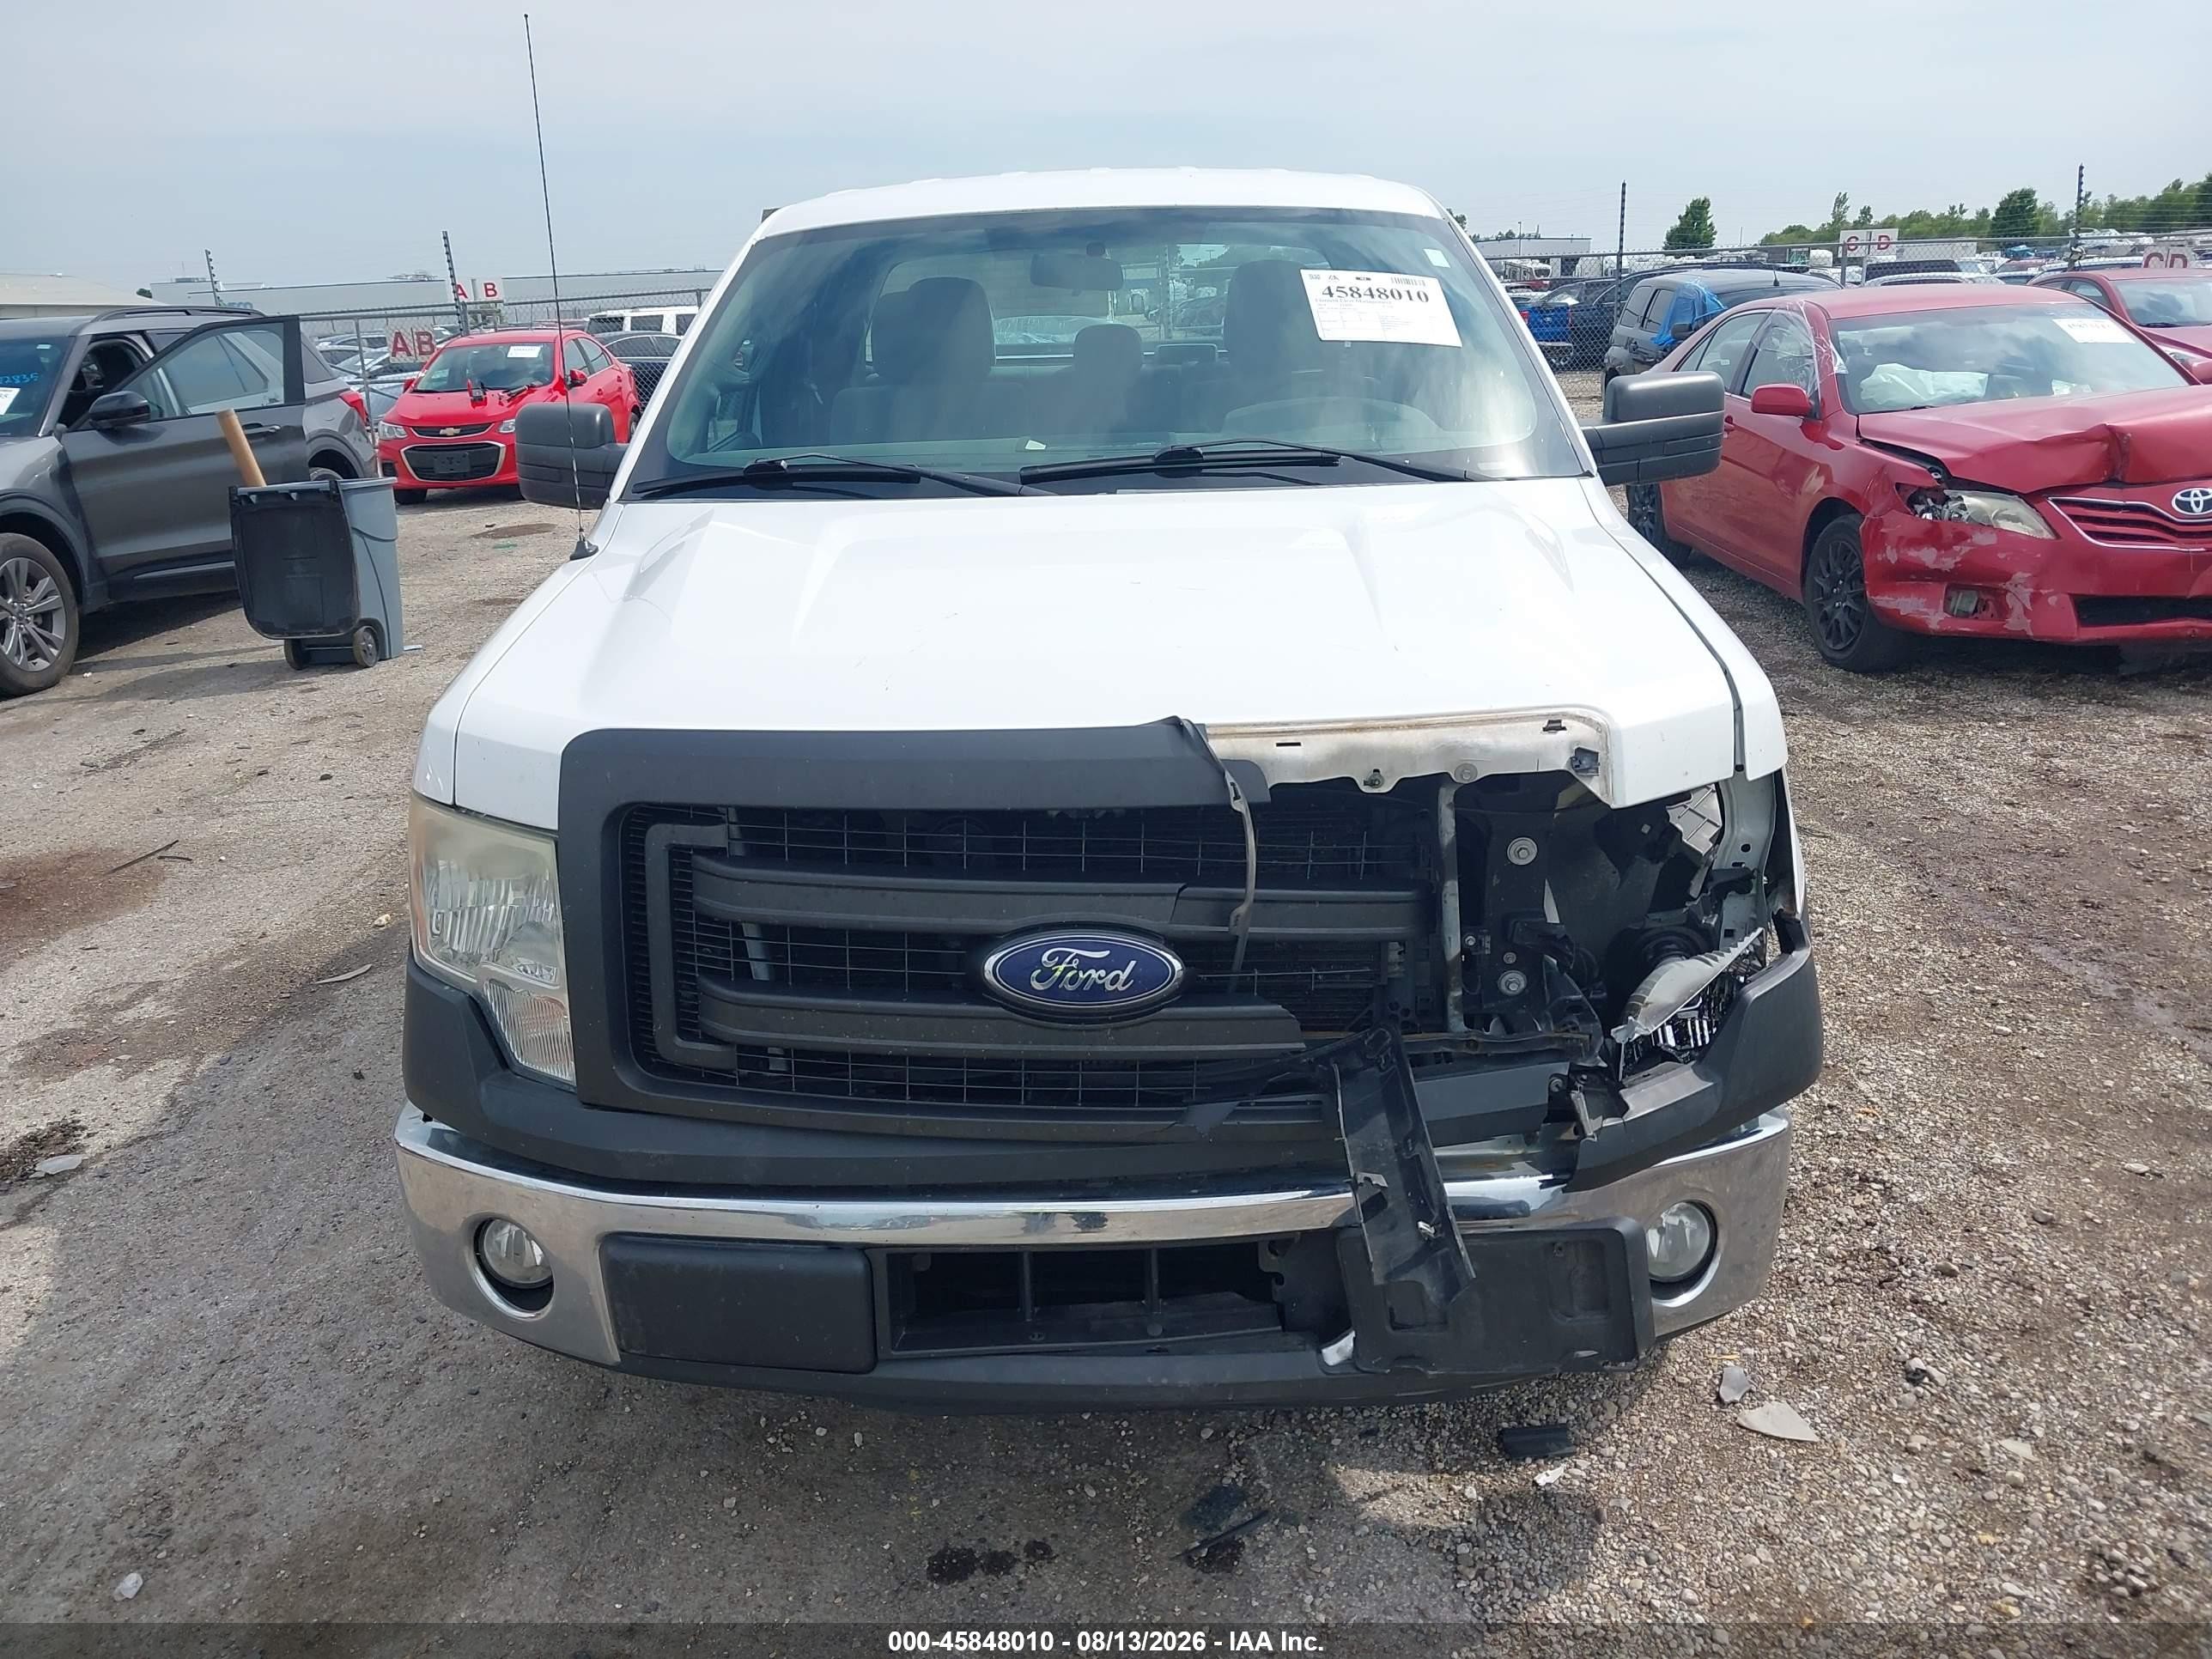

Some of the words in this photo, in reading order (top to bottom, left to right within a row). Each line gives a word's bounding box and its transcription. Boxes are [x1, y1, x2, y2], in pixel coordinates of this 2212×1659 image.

[1846, 235, 1859, 252] C
[1876, 234, 1891, 251] D
[456, 283, 468, 299] A
[483, 282, 498, 298] B
[1322, 285, 1429, 303] 45848010
[391, 331, 412, 357] A
[414, 331, 436, 356] B
[1030, 947, 1138, 992] Ford
